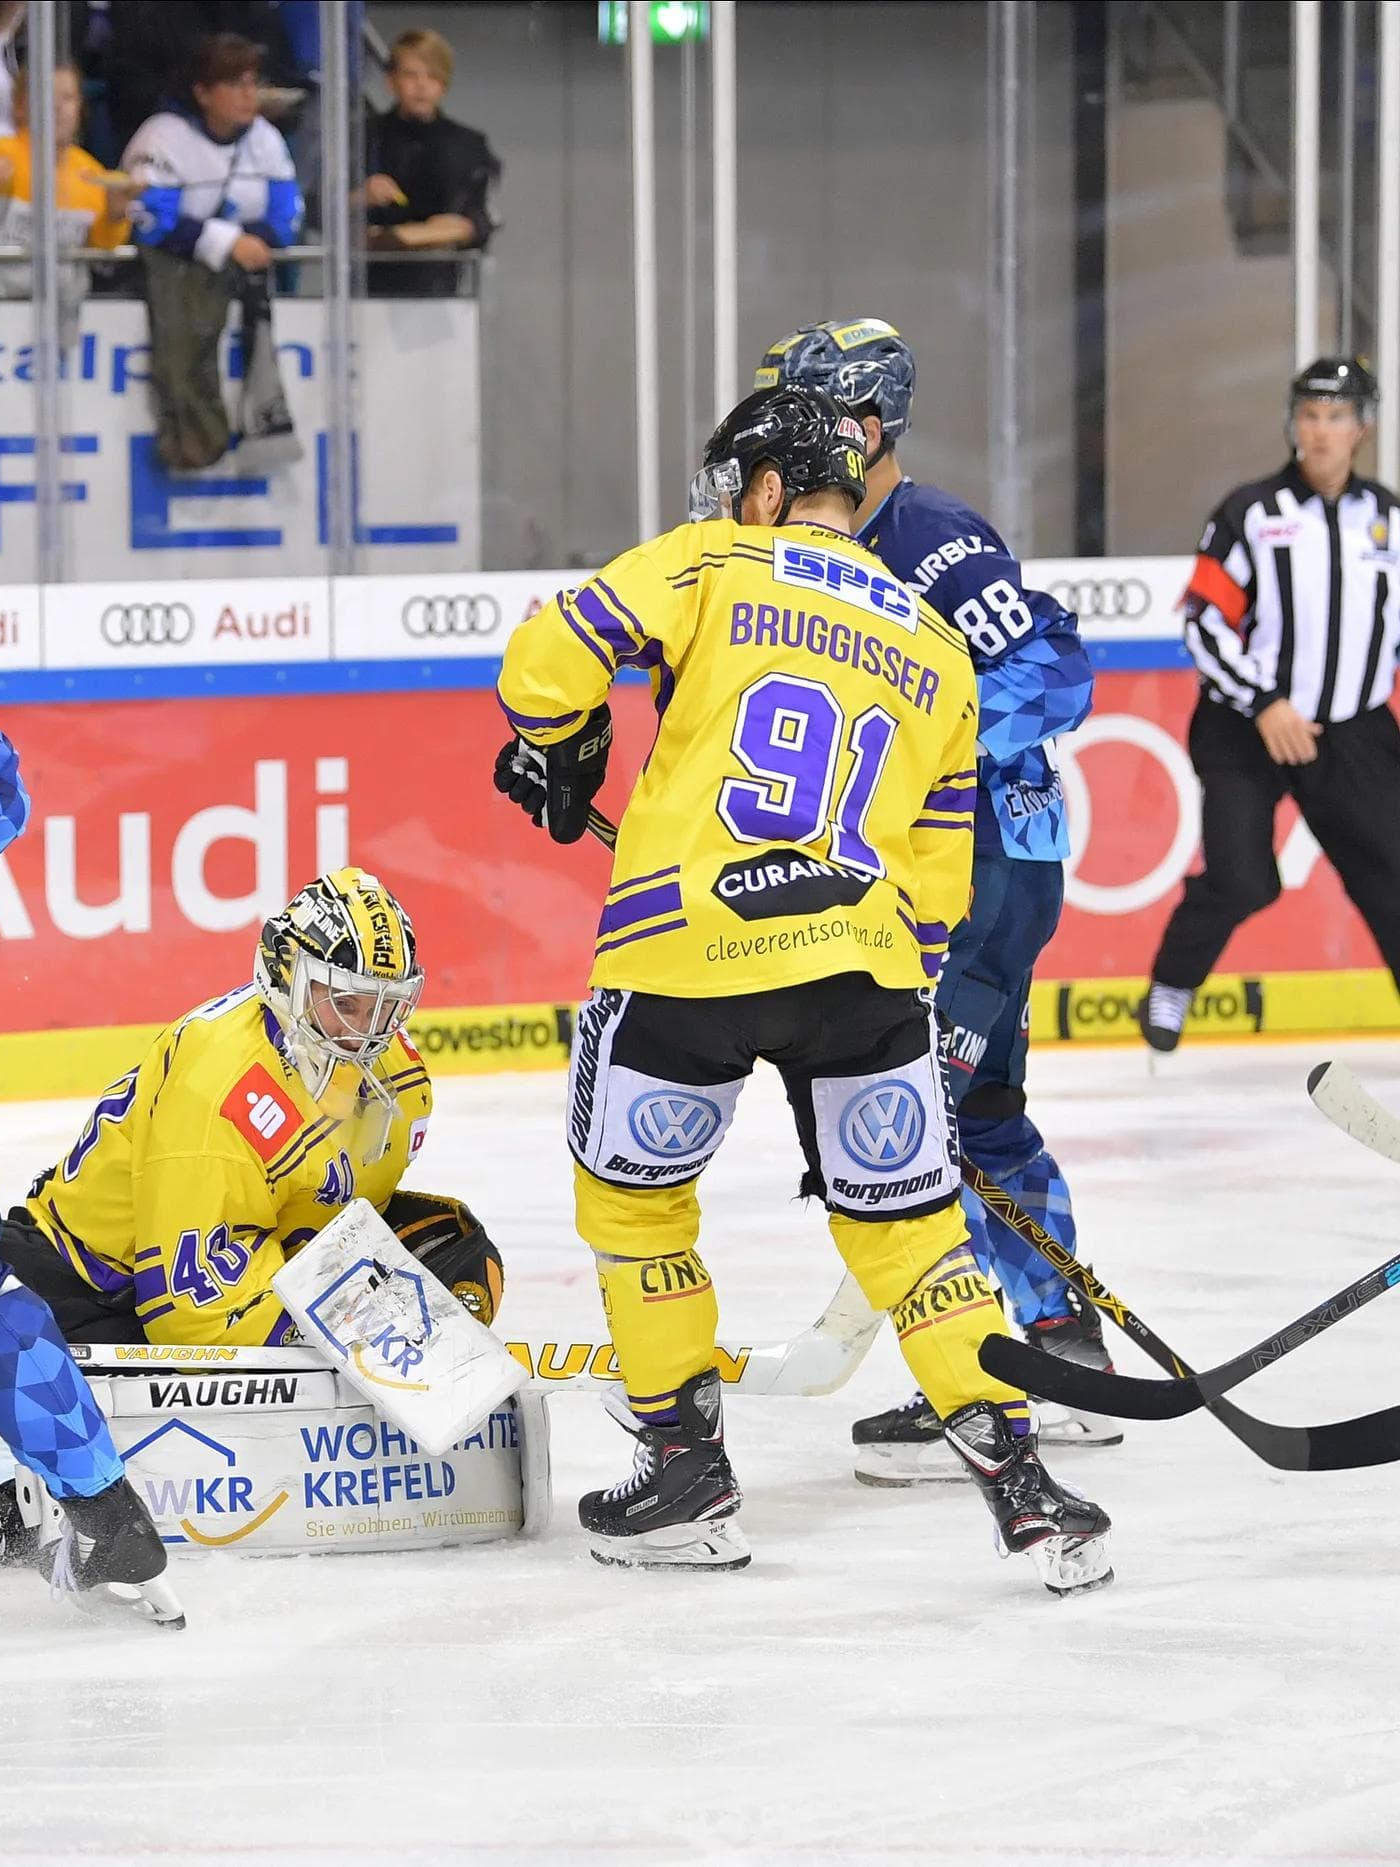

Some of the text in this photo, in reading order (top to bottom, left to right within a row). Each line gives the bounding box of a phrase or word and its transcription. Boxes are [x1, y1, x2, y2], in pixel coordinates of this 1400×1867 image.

[906, 535, 997, 596] AIRBU
[213, 605, 311, 640] Audi
[954, 578, 1033, 658] 88
[731, 602, 940, 716] BRUGGISSER
[716, 671, 901, 880] 91
[717, 859, 873, 897] CURAN
[1075, 990, 1240, 1024] covtro
[408, 1017, 549, 1052] covestro
[832, 1166, 943, 1204] Borgmann
[169, 1220, 252, 1309] 40
[1251, 1276, 1384, 1371] NEXUS
[114, 1346, 240, 1361] VAUGHN
[503, 1342, 753, 1383] AUGN
[149, 1377, 298, 1408] VAUGHN
[145, 1475, 256, 1515] WKR
[304, 1459, 456, 1509] KREFELD
[306, 1521, 336, 1538] Sie
